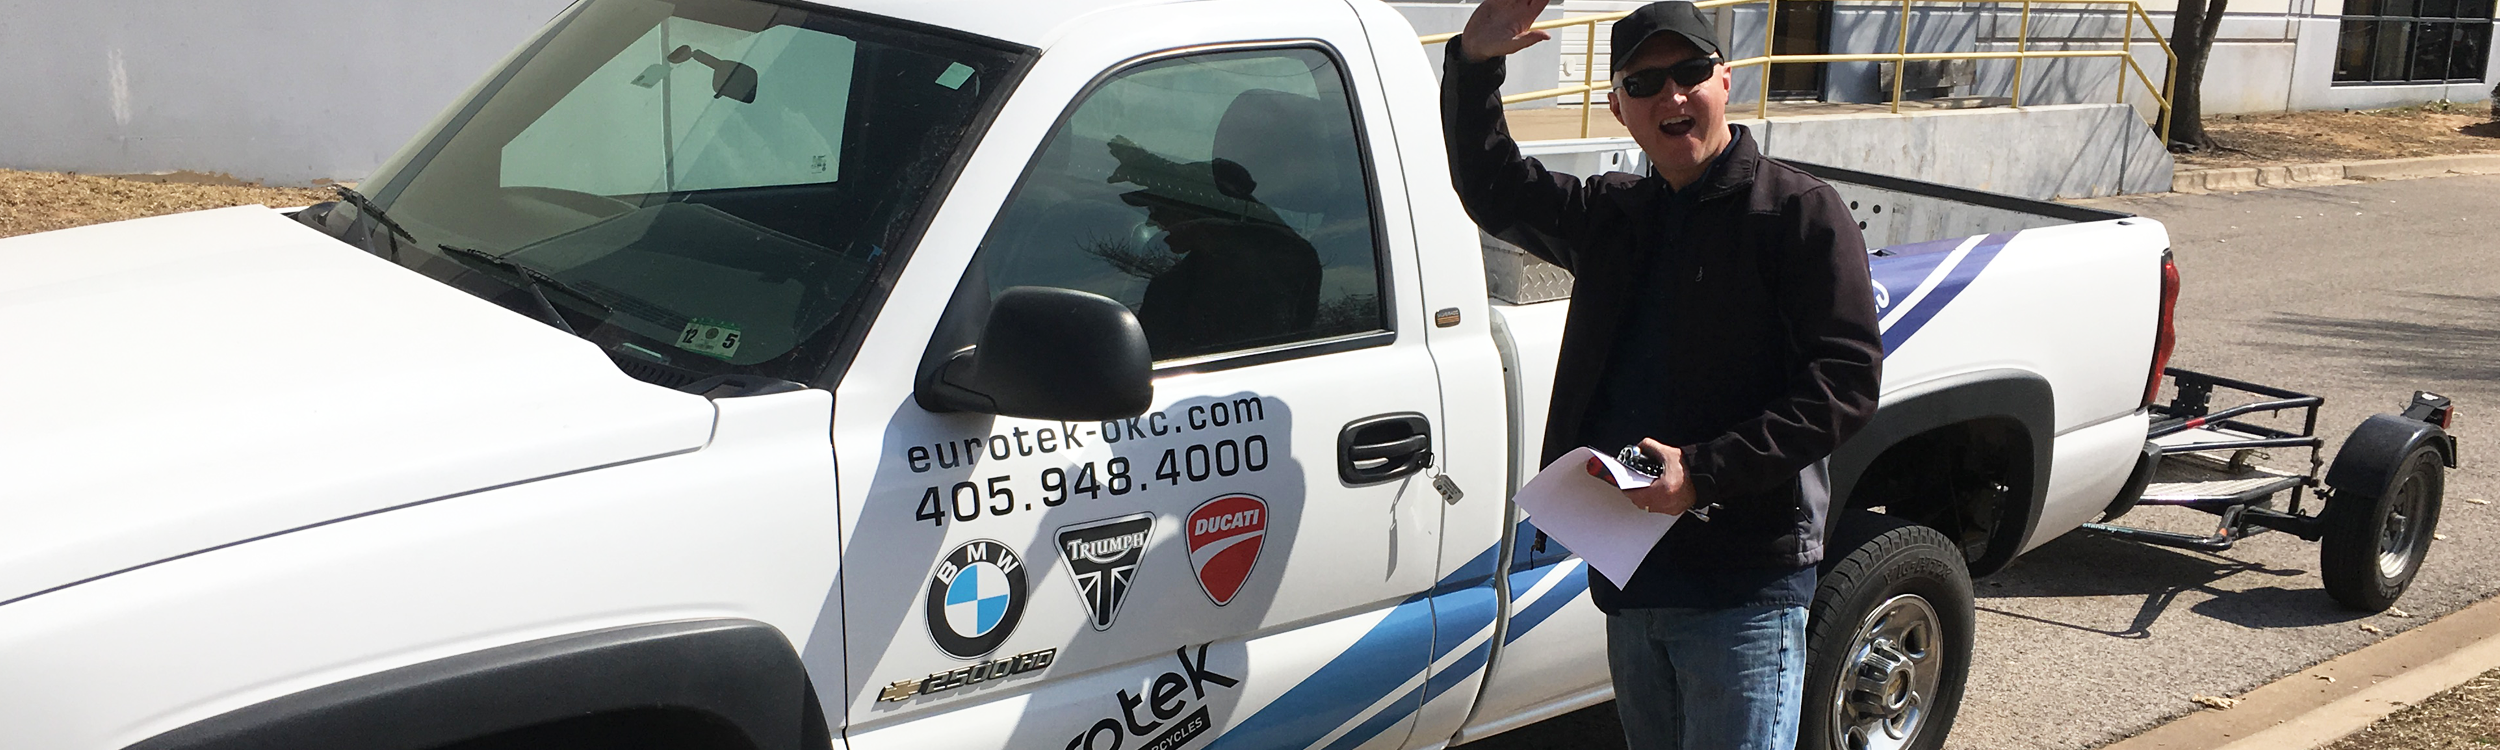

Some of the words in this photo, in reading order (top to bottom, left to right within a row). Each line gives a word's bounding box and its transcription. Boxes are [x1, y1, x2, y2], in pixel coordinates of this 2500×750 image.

[682, 328, 699, 344] 12
[722, 333, 739, 349] 5
[907, 396, 1264, 474] eurotek-okc.com
[915, 434, 1269, 527] 405.948.4000
[1194, 508, 1260, 536] DUCATI
[936, 542, 1020, 586] BMW
[1066, 530, 1146, 561] TRIUMPH
